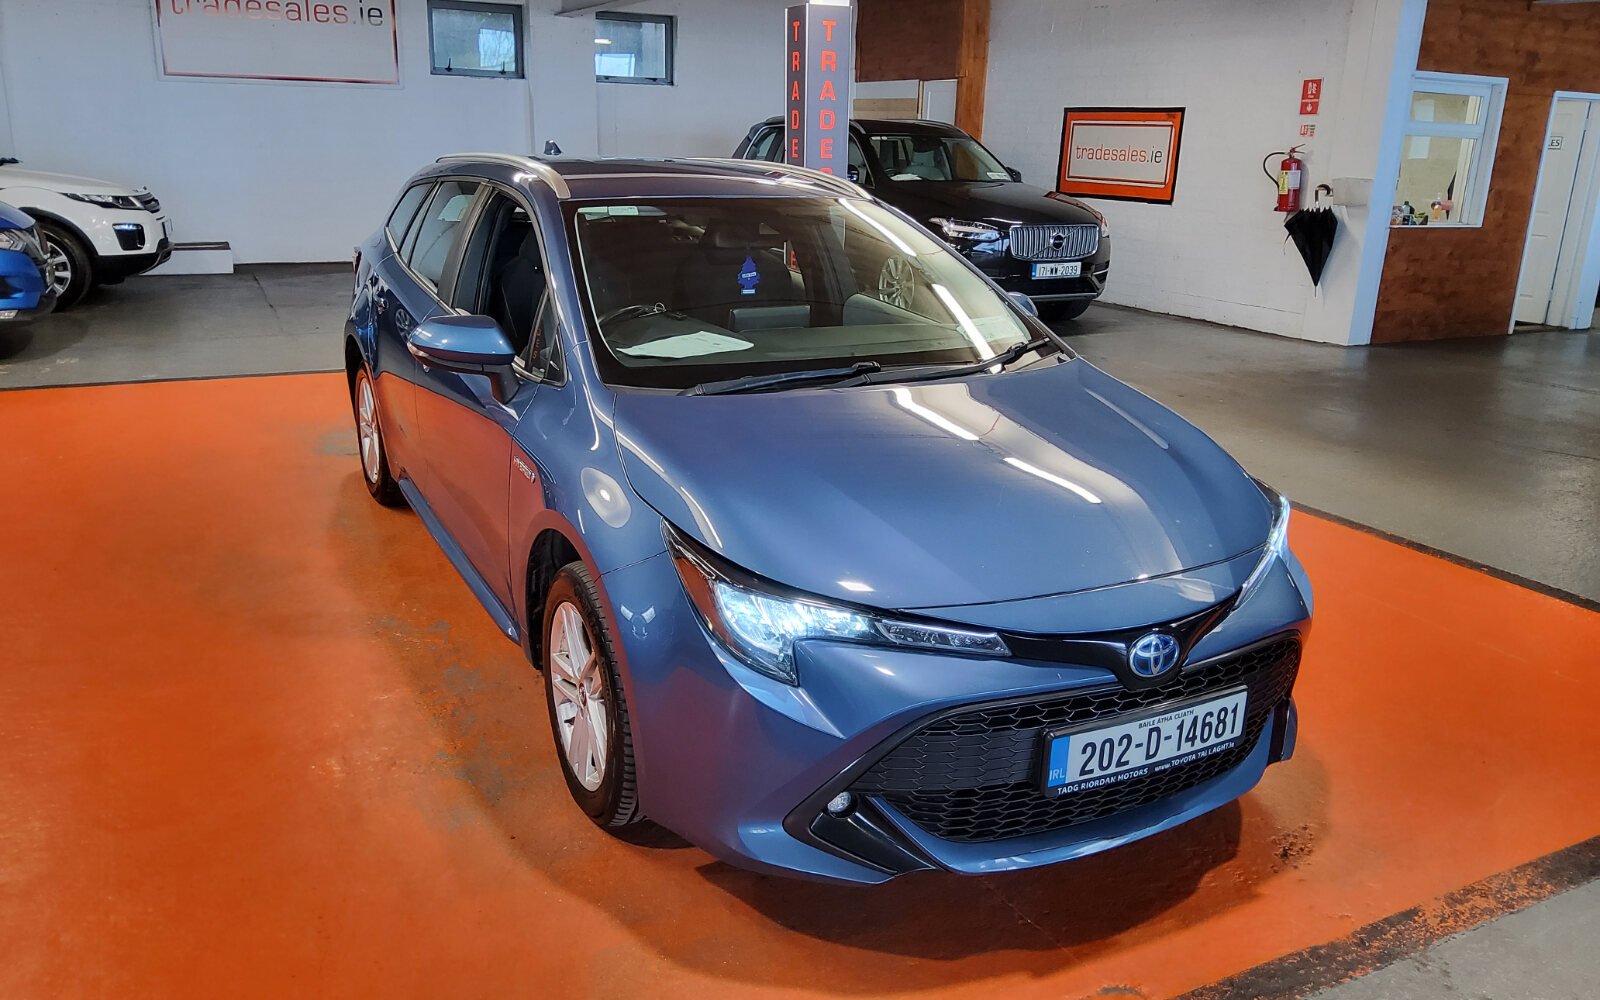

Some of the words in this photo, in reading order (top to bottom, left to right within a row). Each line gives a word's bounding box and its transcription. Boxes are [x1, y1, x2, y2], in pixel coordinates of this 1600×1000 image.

[171, 0, 384, 27] tradesales.ie
[791, 20, 801, 159] TRADE
[1075, 144, 1163, 164] tradesales.ie
[1138, 719, 1156, 729] BAILE
[1079, 702, 1239, 777] 202-D-14681
[1049, 768, 1066, 781] IRL
[1057, 784, 1080, 796] TADG
[1080, 775, 1116, 790] RIORDAN
[1117, 767, 1149, 782] MOTORS
